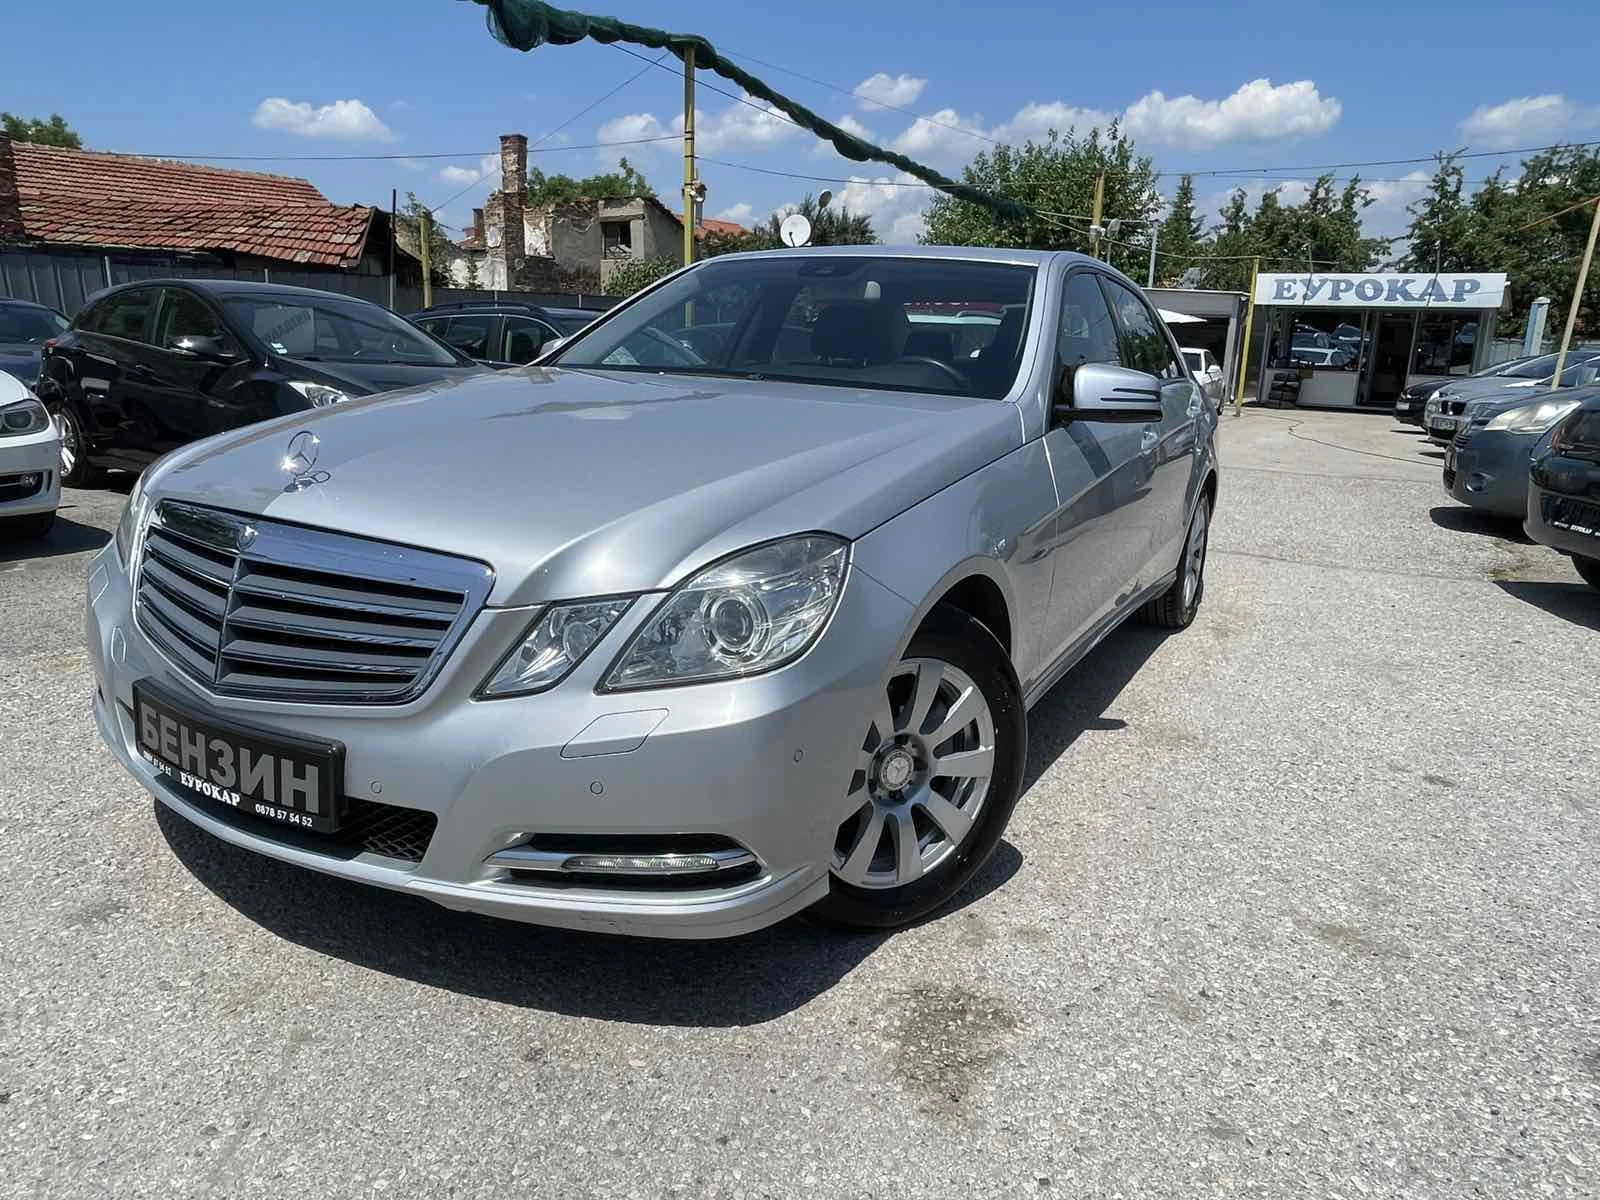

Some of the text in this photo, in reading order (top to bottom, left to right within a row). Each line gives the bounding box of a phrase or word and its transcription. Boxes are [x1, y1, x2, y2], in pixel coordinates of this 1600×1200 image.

[1272, 278, 1481, 303] ЕУРОКАР
[140, 702, 319, 814] БЕНЗИН
[180, 771, 241, 806] ЕУРОКАР
[277, 809, 288, 820] 57
[289, 812, 300, 824] 54
[301, 816, 313, 827] 52
